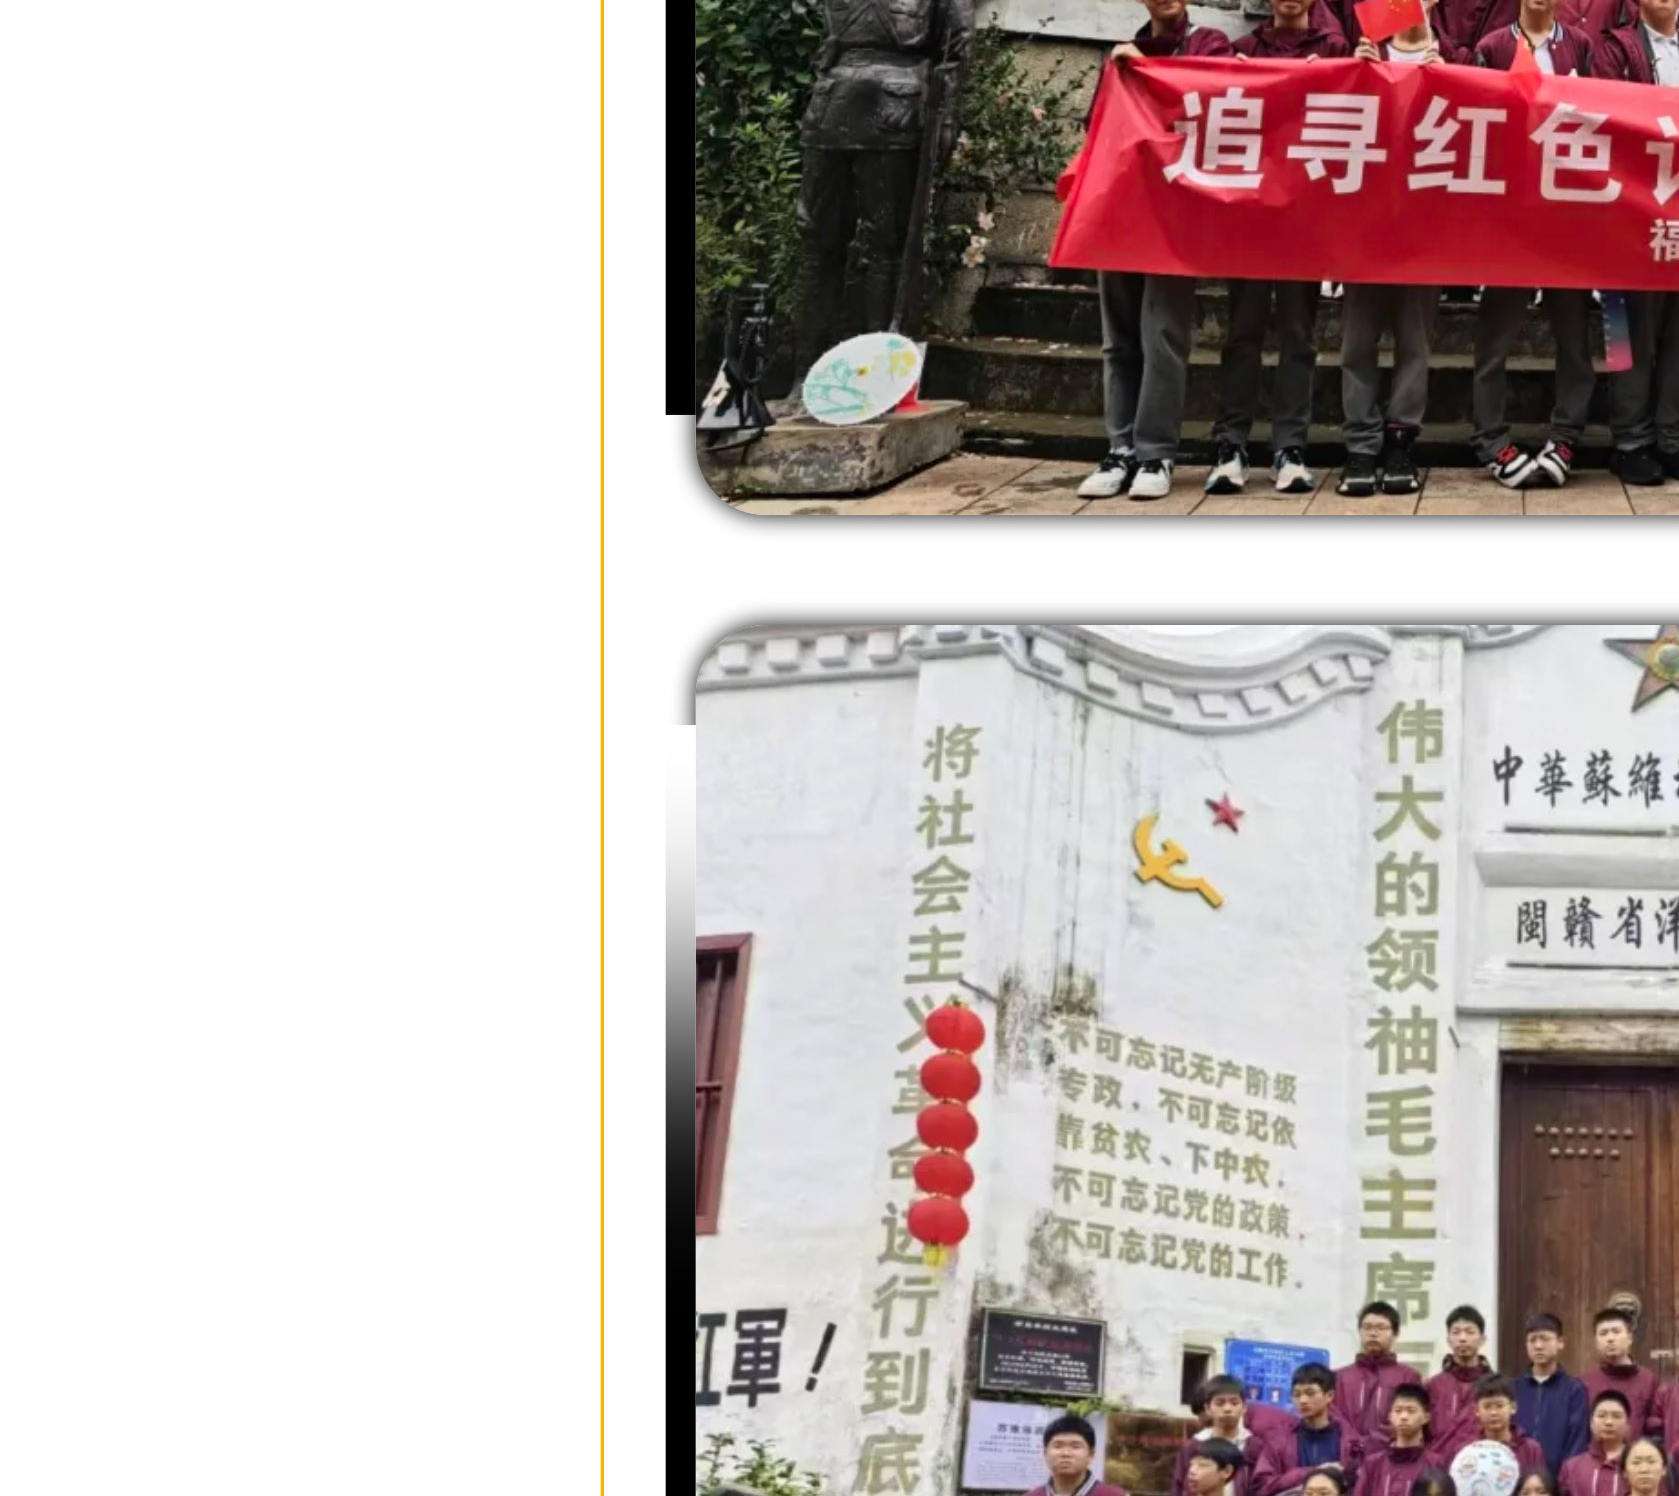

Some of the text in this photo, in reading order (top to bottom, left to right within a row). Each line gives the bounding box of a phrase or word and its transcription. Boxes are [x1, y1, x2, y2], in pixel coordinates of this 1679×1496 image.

[1058, 1017, 1299, 1106] 不可忘记无产阶级
[1359, 699, 1444, 1375] 伟大的领袖毛主席
